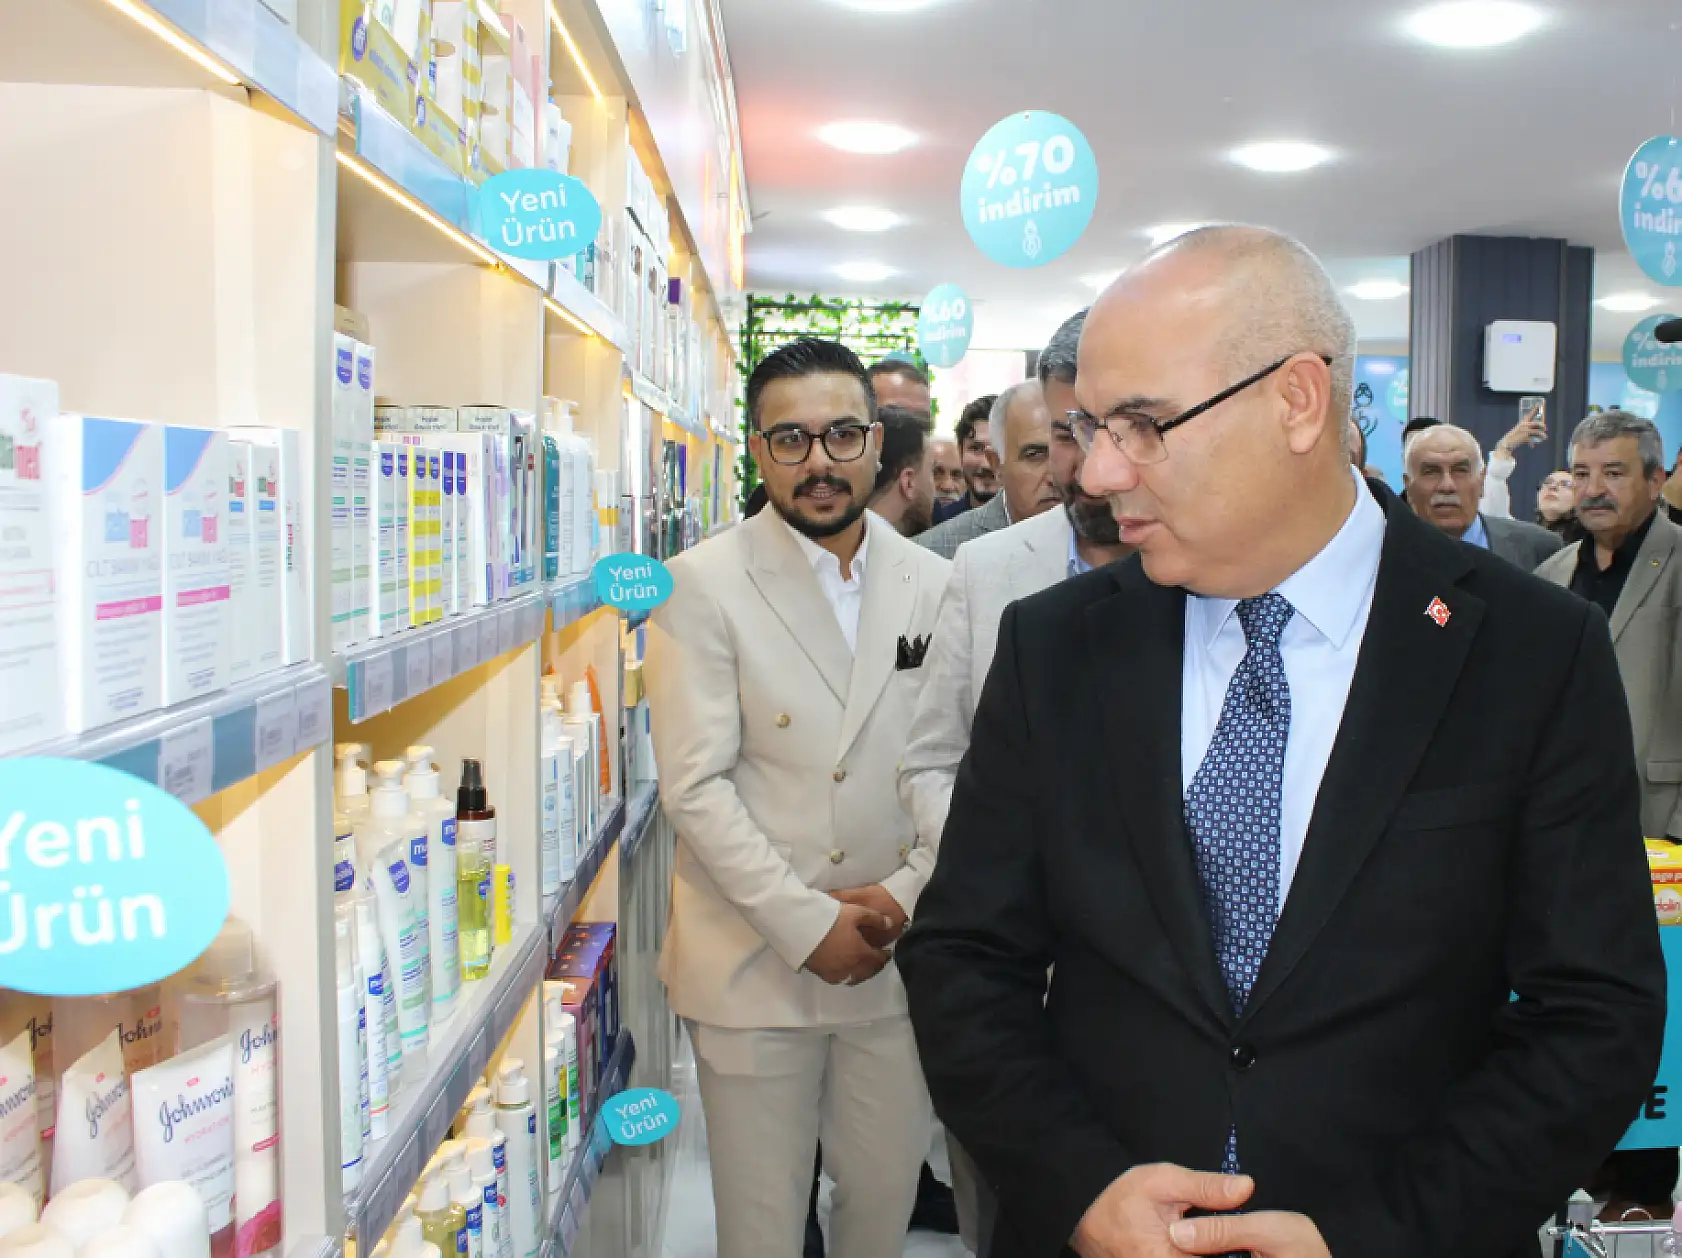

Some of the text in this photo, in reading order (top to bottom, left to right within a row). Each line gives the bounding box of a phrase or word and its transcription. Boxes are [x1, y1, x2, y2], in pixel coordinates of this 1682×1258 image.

[975, 134, 1074, 190] %70
[500, 183, 567, 214] Yeni
[979, 181, 1080, 224] indirim
[501, 216, 576, 247] Ürün
[608, 561, 652, 582] Yeni
[609, 582, 658, 602] Ürün
[614, 1092, 658, 1119] Yeni
[621, 1112, 669, 1139] Ürün
